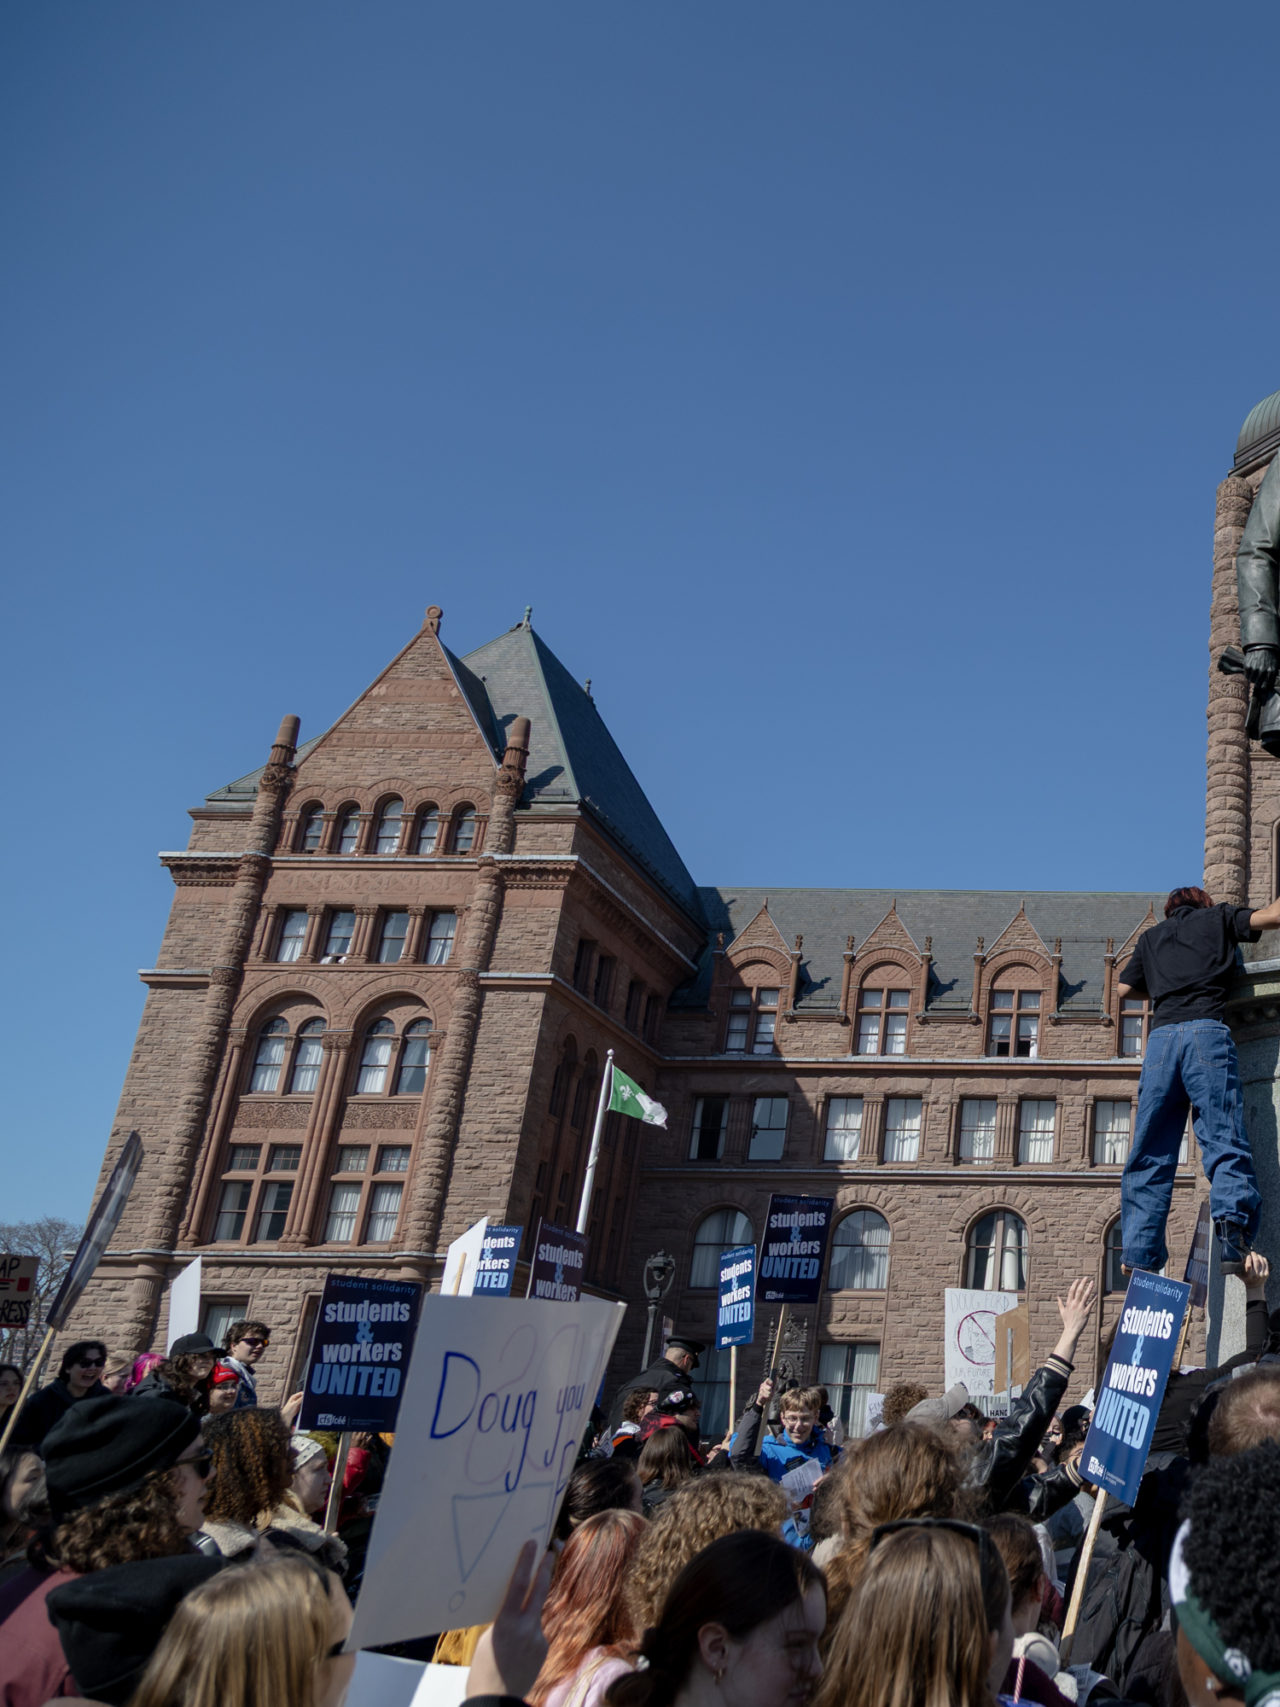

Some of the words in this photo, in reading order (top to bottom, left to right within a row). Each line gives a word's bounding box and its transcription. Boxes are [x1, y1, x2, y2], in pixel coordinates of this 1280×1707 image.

[770, 1211, 825, 1228] students
[790, 1226, 802, 1242] &
[483, 1248, 494, 1260] &
[538, 1243, 584, 1268] students
[769, 1241, 820, 1256] workers
[720, 1259, 752, 1283] students
[761, 1256, 820, 1279] UNITED
[330, 1279, 368, 1290] student
[372, 1283, 416, 1296] solidarity
[536, 1279, 577, 1302] workers
[721, 1285, 750, 1307] workers
[1133, 1276, 1155, 1292] student
[1155, 1280, 1183, 1302] solidarity
[324, 1300, 411, 1322] students
[718, 1301, 751, 1327] UNITED
[1121, 1305, 1174, 1340] students
[356, 1320, 374, 1343] &
[322, 1340, 402, 1363] workers
[1131, 1334, 1144, 1365] &
[311, 1363, 402, 1397] UNITED
[1108, 1362, 1158, 1397] workers
[430, 1351, 537, 1493] Doug
[544, 1383, 586, 1467] you
[1094, 1387, 1150, 1450] UNITED
